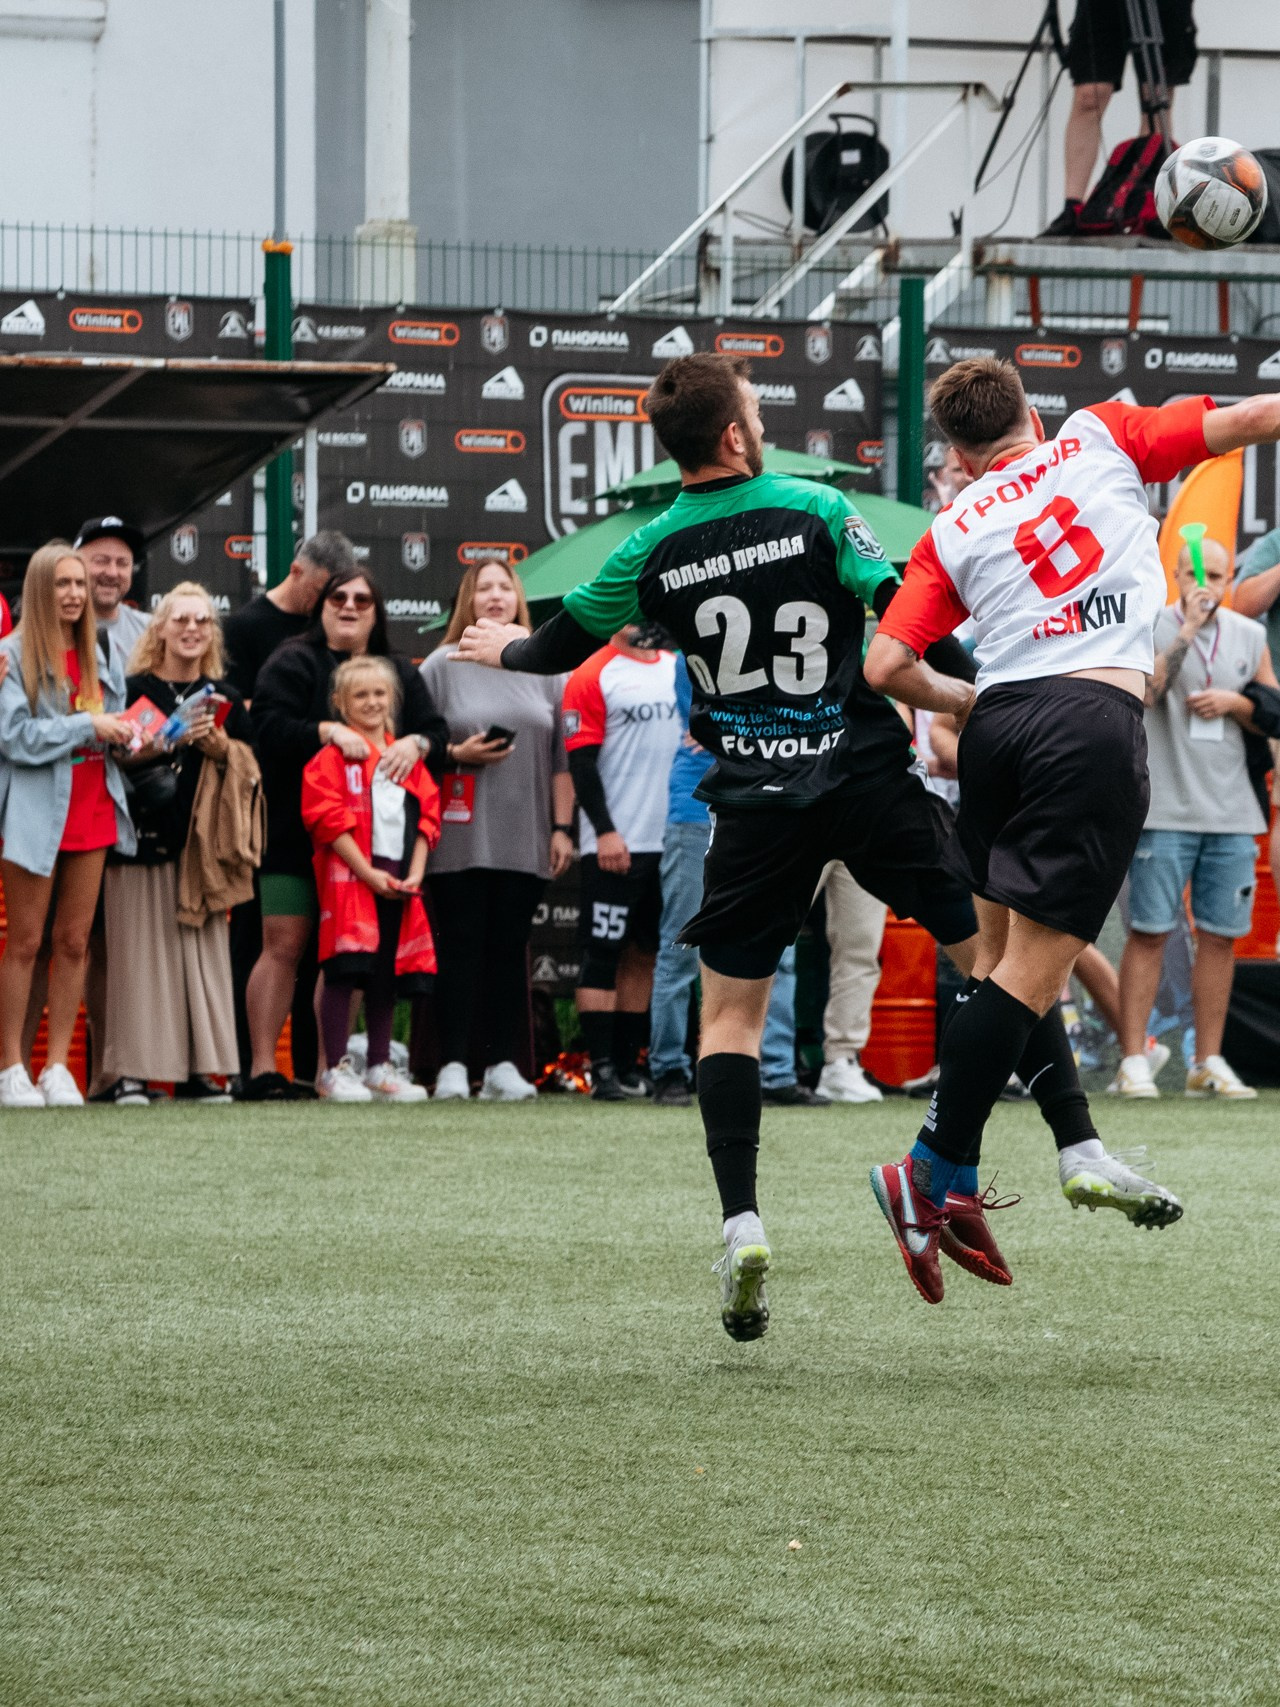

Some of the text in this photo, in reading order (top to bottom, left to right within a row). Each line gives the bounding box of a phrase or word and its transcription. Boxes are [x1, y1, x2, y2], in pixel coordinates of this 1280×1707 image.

[76, 314, 122, 327] Winline
[394, 325, 440, 339] Winline
[552, 330, 629, 346] ПАНОРАМА
[1165, 351, 1238, 368] ПАНОРАМА
[568, 395, 636, 415] Winline
[461, 436, 505, 447] Winline
[370, 484, 449, 501] ПАНОРАМА
[1013, 495, 1105, 599] 8
[659, 534, 805, 593] ТОЛЬКО ПРАВАЯ
[694, 595, 830, 696] 23
[721, 729, 846, 760] FC VOLAT
[592, 902, 629, 941] 55
